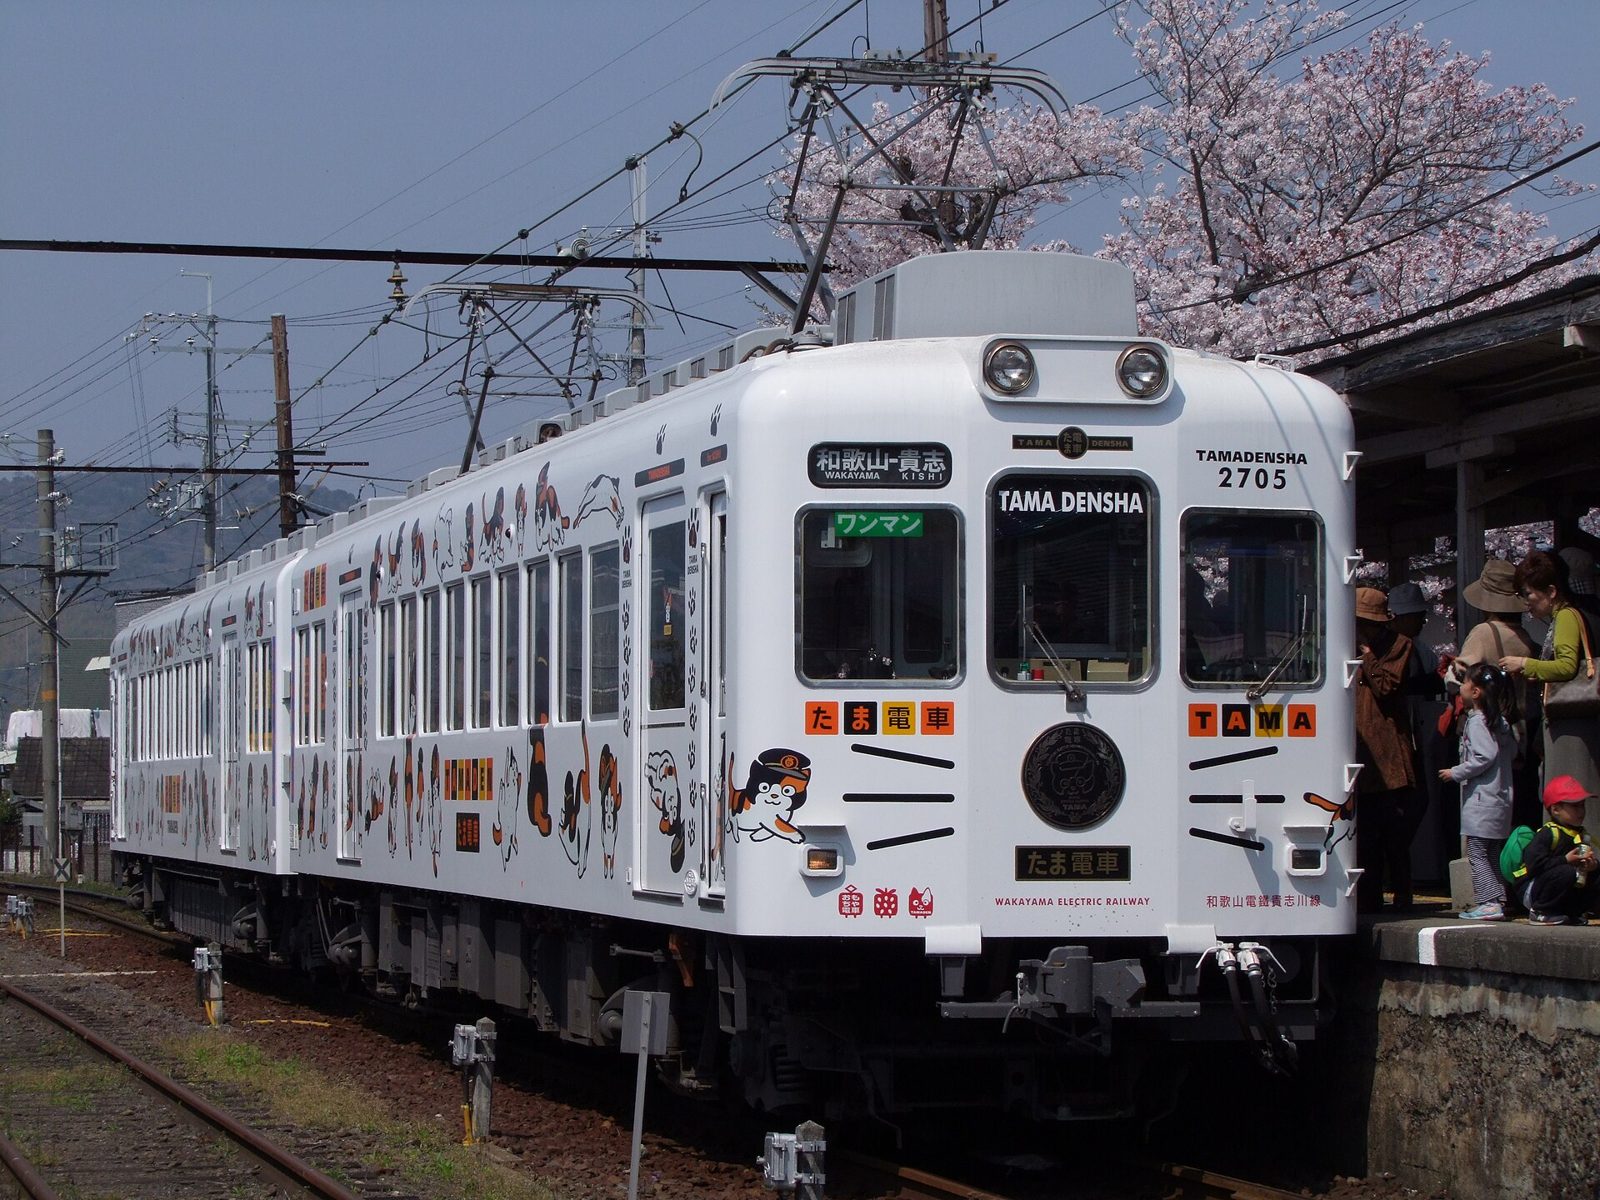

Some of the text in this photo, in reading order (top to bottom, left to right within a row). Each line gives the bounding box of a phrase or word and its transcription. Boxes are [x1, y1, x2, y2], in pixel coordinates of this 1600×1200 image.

[1017, 439, 1129, 448] TAMA DENSHA
[1195, 450, 1308, 465] TAMADENSHA
[825, 471, 943, 481] WAKAYAMA KISHI
[1218, 467, 1287, 490] 2705
[999, 490, 1144, 514] TAMA DENSHA
[837, 514, 921, 535] ワンマン
[811, 705, 951, 732] たま電車
[1193, 709, 1313, 732] TAMA
[1027, 850, 1120, 876] たま電車
[995, 897, 1150, 906] WAKAYAMA ELECTRIC RAILWAY
